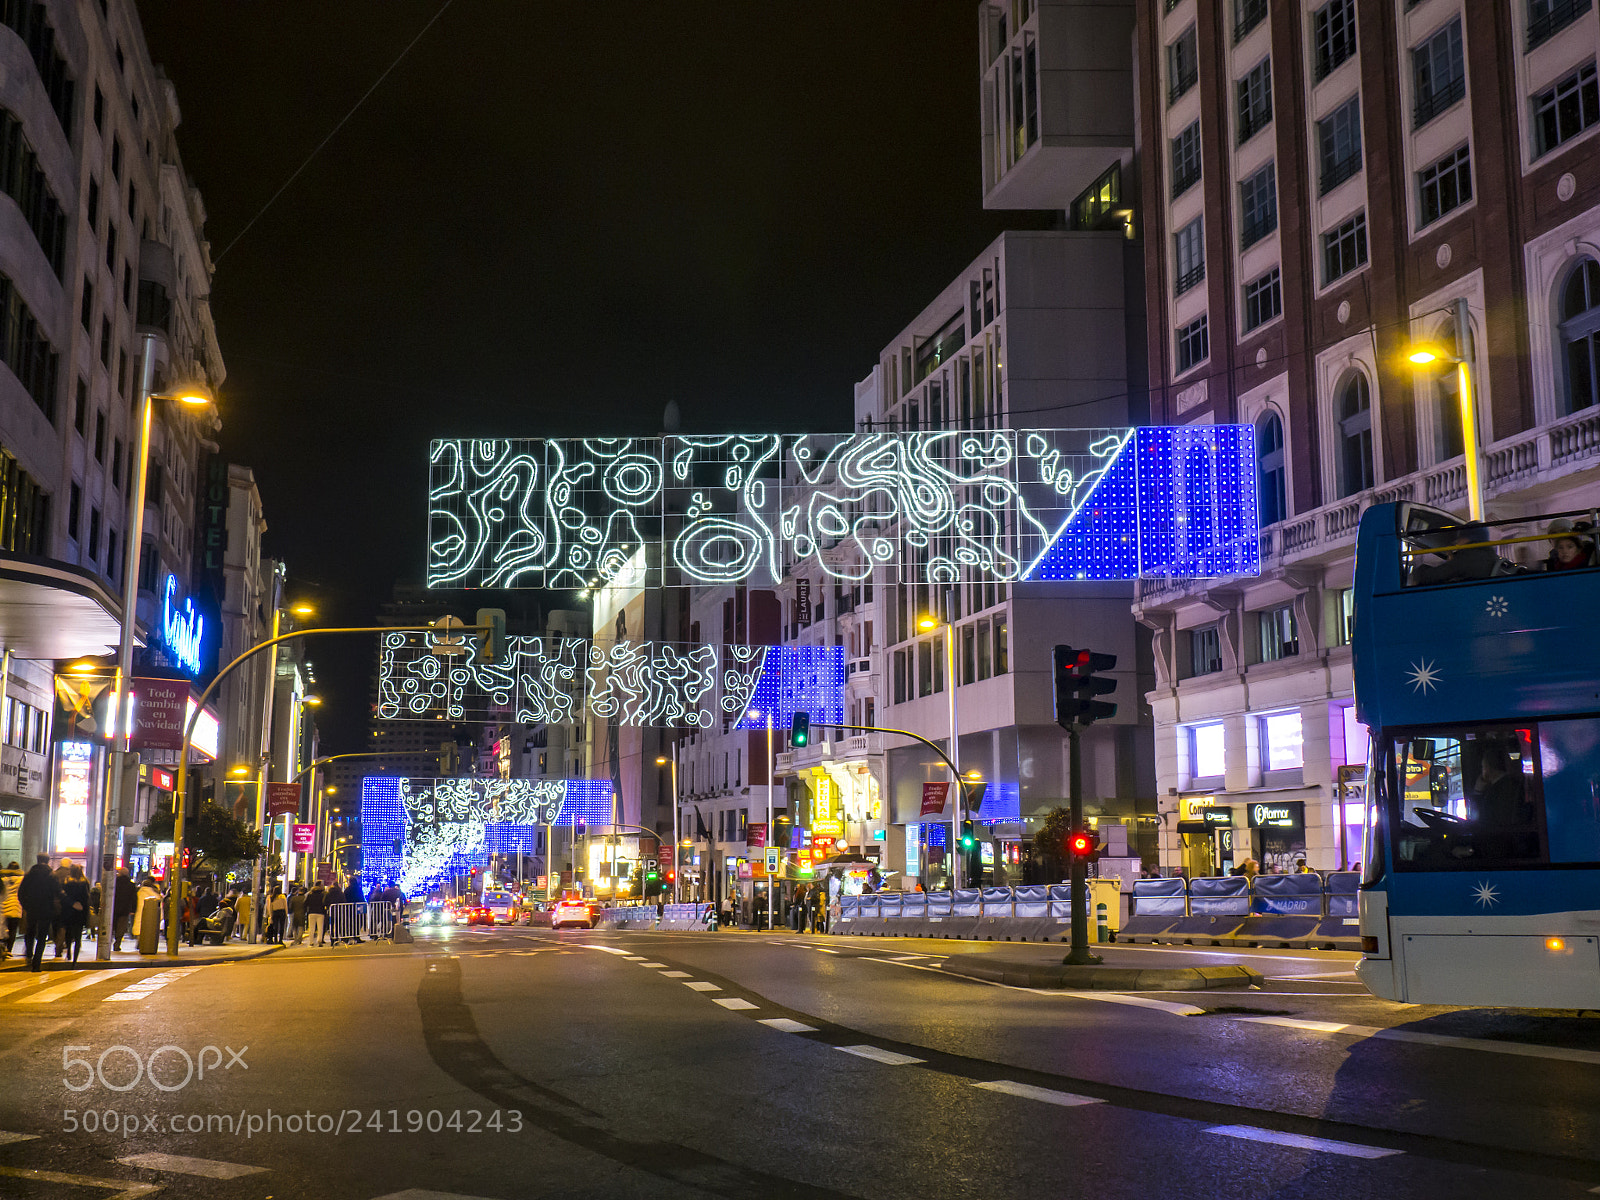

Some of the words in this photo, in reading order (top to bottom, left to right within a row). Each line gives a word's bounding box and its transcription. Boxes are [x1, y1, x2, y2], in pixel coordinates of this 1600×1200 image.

[147, 688, 175, 698] Todo
[140, 700, 180, 710] cambia
[152, 711, 166, 719] en
[136, 719, 181, 730] Navidad
[1406, 765, 1422, 773] etro
[1189, 800, 1214, 815] Comid
[647, 860, 657, 871] P
[1277, 901, 1308, 910] MADRID
